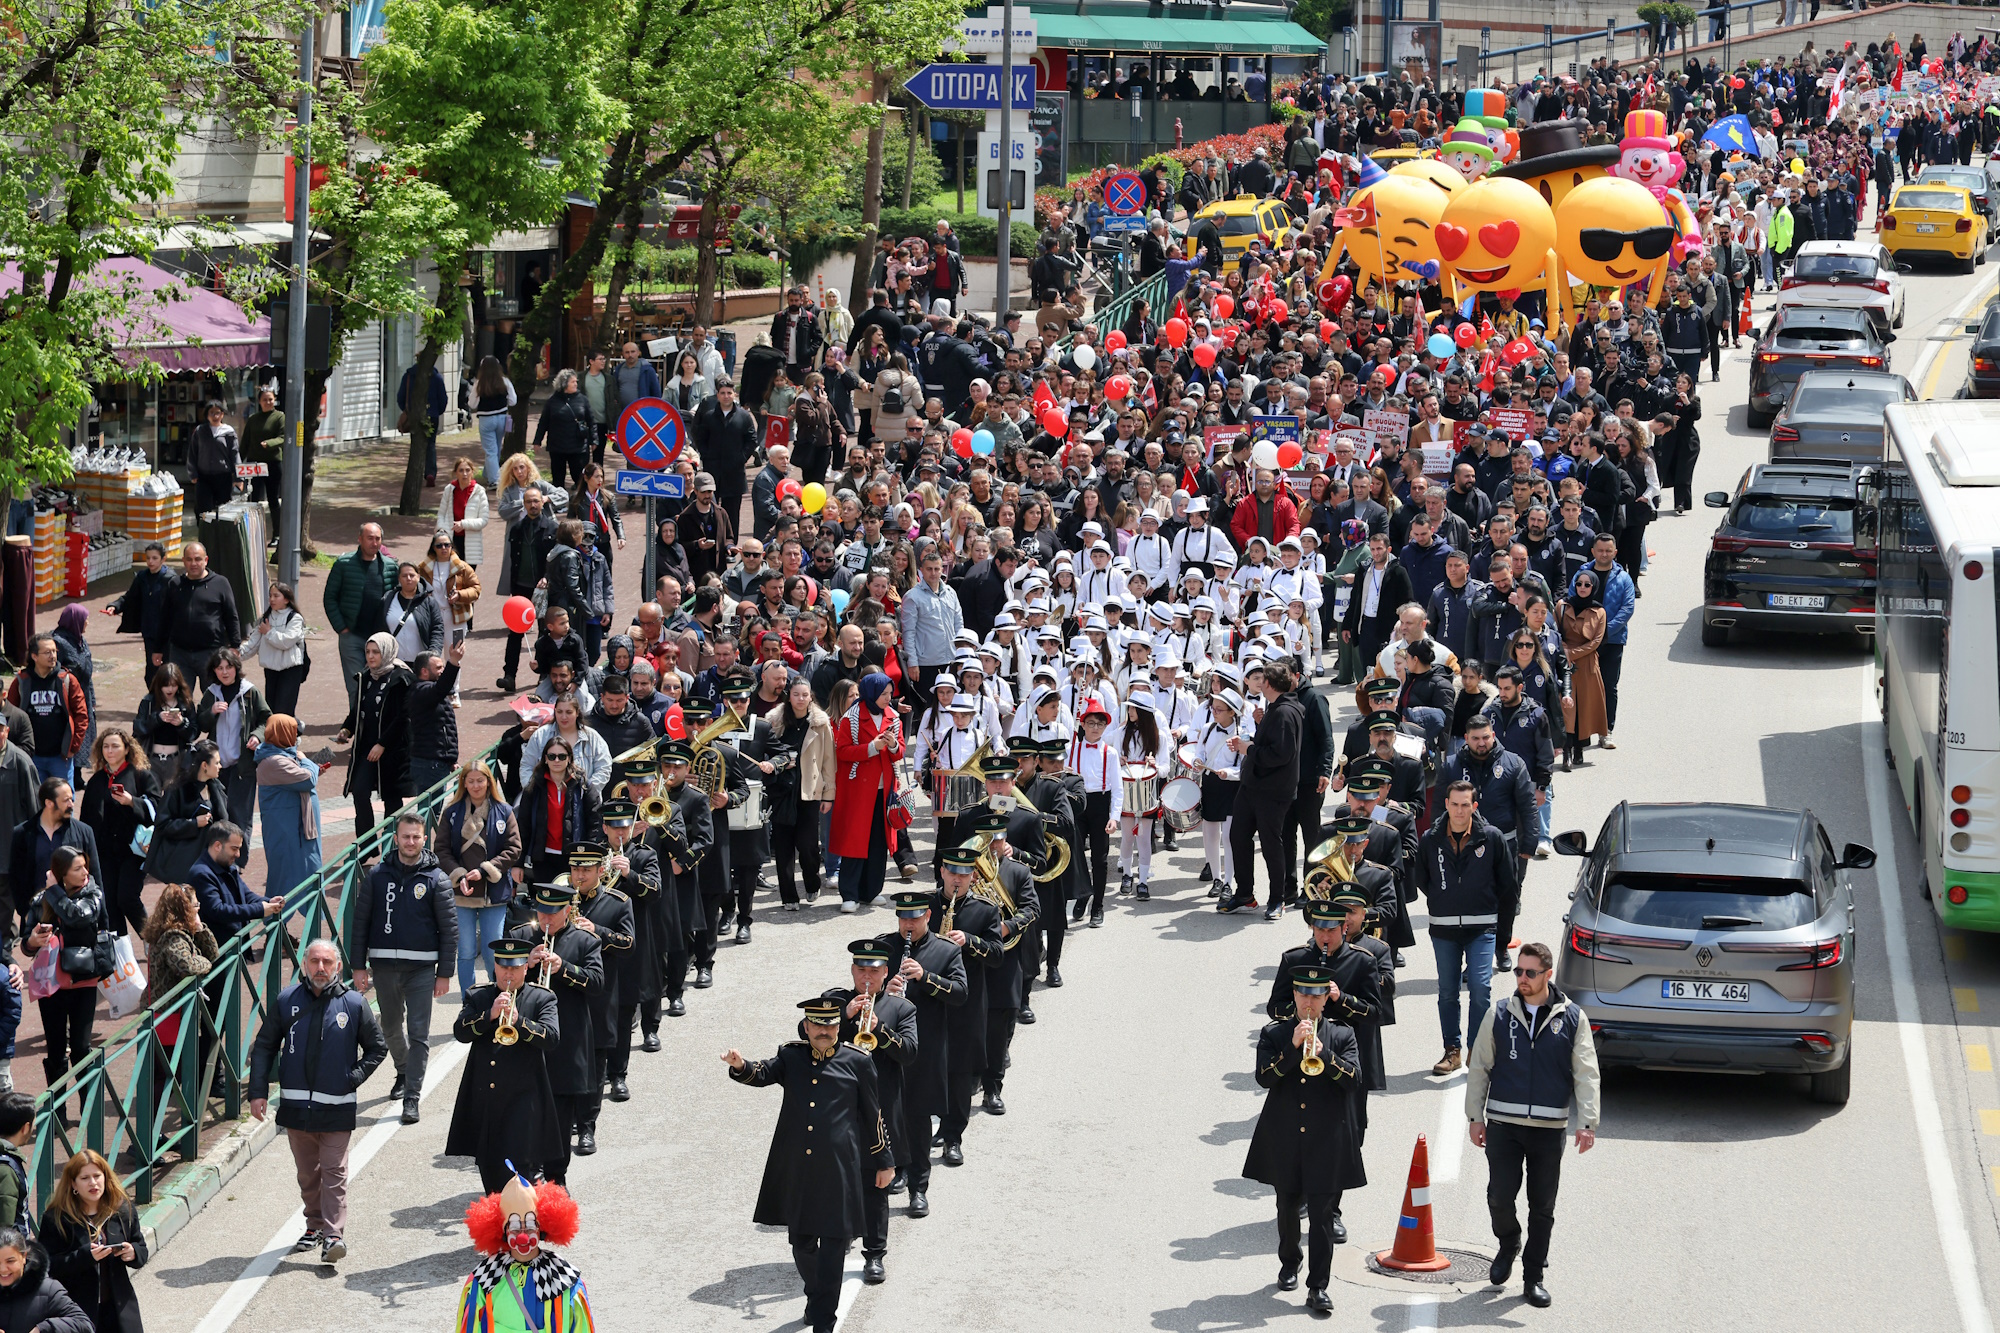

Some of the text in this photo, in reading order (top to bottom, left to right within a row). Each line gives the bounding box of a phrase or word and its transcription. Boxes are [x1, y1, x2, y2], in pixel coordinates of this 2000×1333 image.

[931, 72, 1028, 102] OTOPAK
[990, 139, 1024, 161] GİŞ
[1269, 433, 1291, 441] NİSAN
[1275, 427, 1285, 435] 23
[237, 465, 262, 476] 250
[1773, 595, 1823, 607] 06 EKT 264
[102, 961, 136, 989] FLO
[1677, 969, 1731, 977] AUSTRAL
[1671, 982, 1685, 996] 16
[1692, 983, 1713, 998] YK
[1721, 984, 1747, 1000] 464
